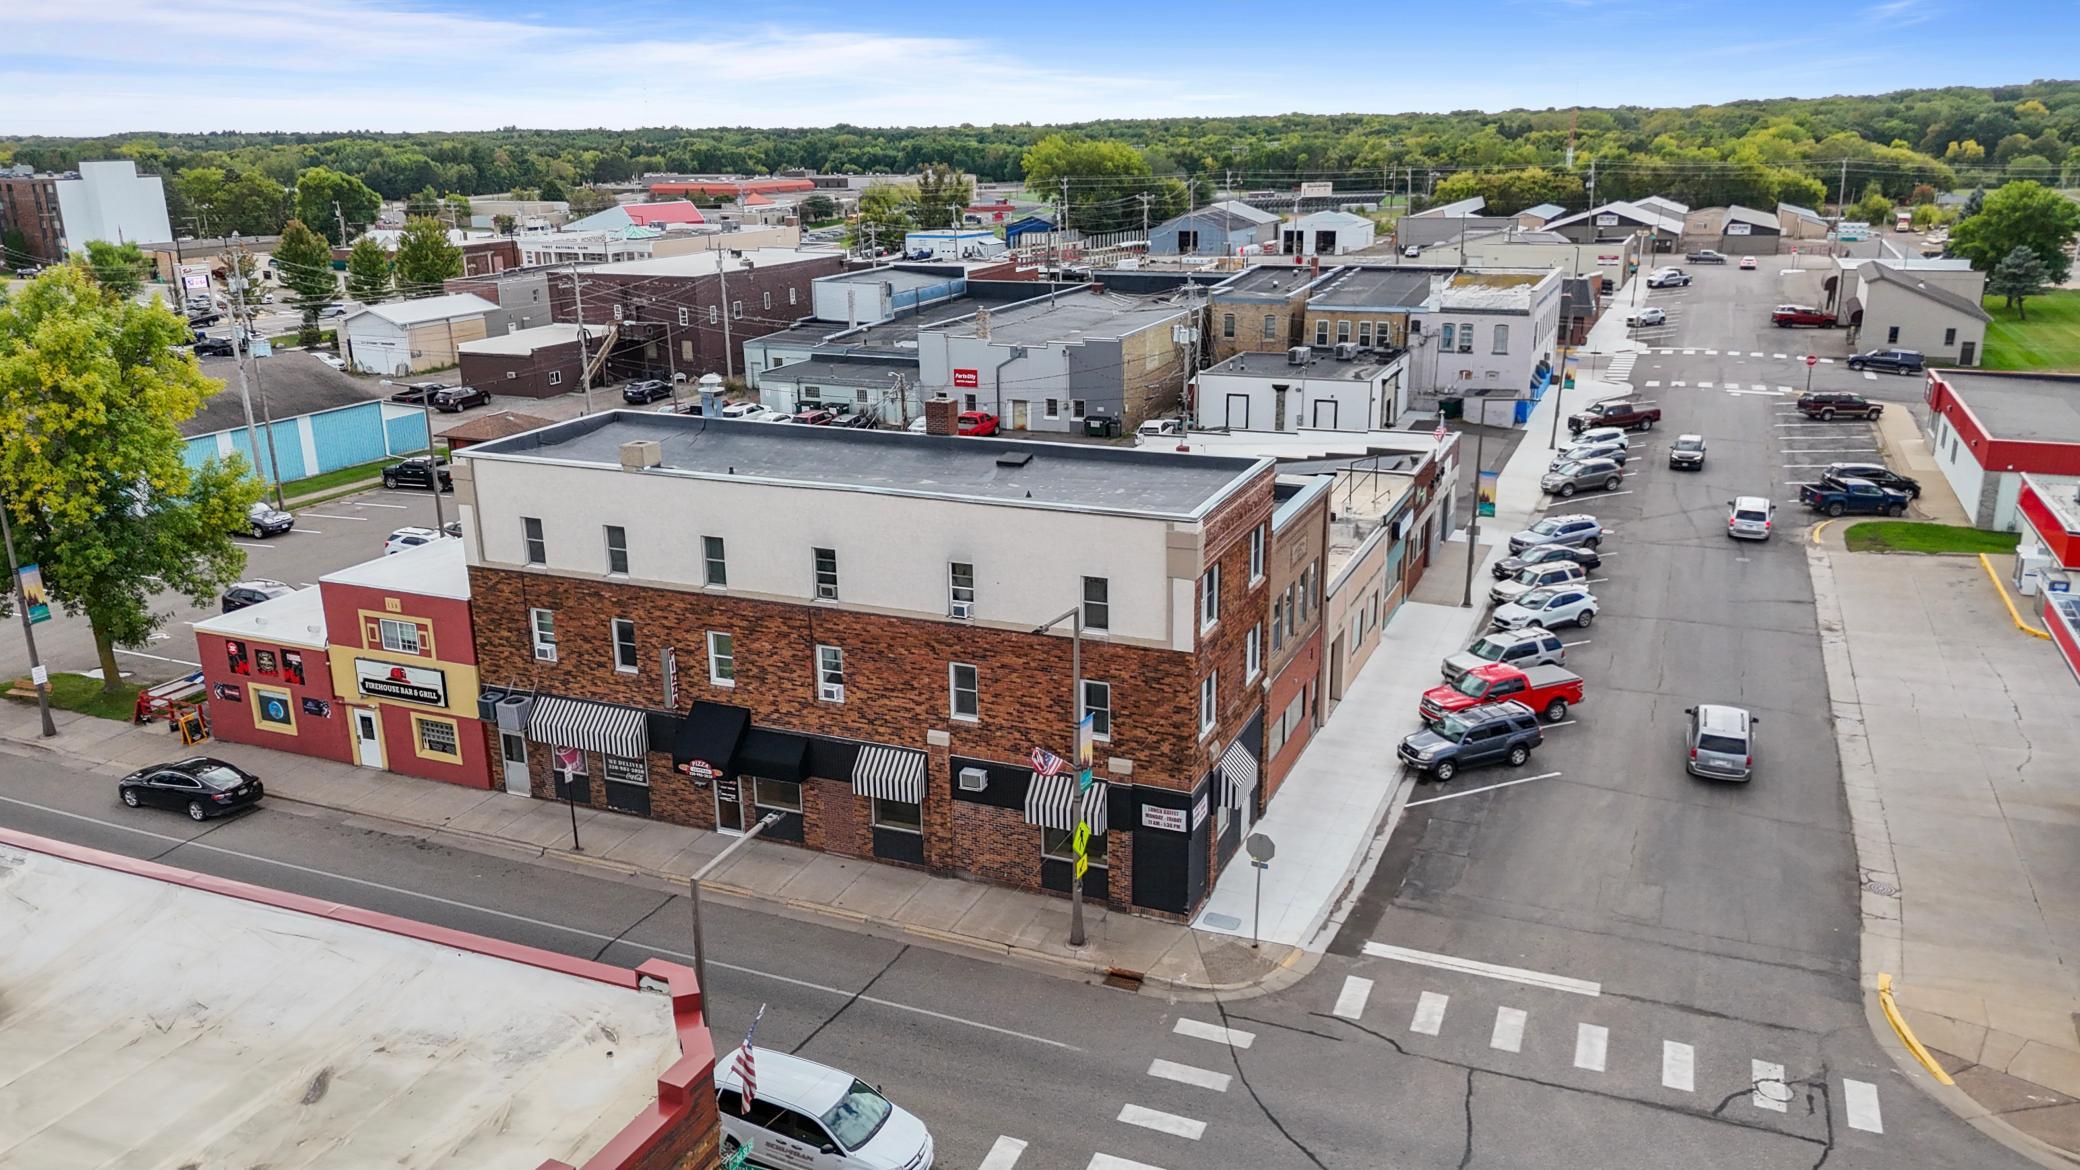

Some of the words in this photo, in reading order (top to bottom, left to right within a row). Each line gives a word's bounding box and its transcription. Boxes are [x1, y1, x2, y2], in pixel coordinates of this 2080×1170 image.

[669, 649, 679, 706] PIZZA
[364, 681, 400, 694] FIREHOUSE
[400, 687, 413, 696] BAR
[419, 690, 438, 699] GRILL
[618, 760, 643, 769] DELIVER
[691, 760, 709, 768] PIZZA
[1145, 812, 1164, 820] MONDAY
